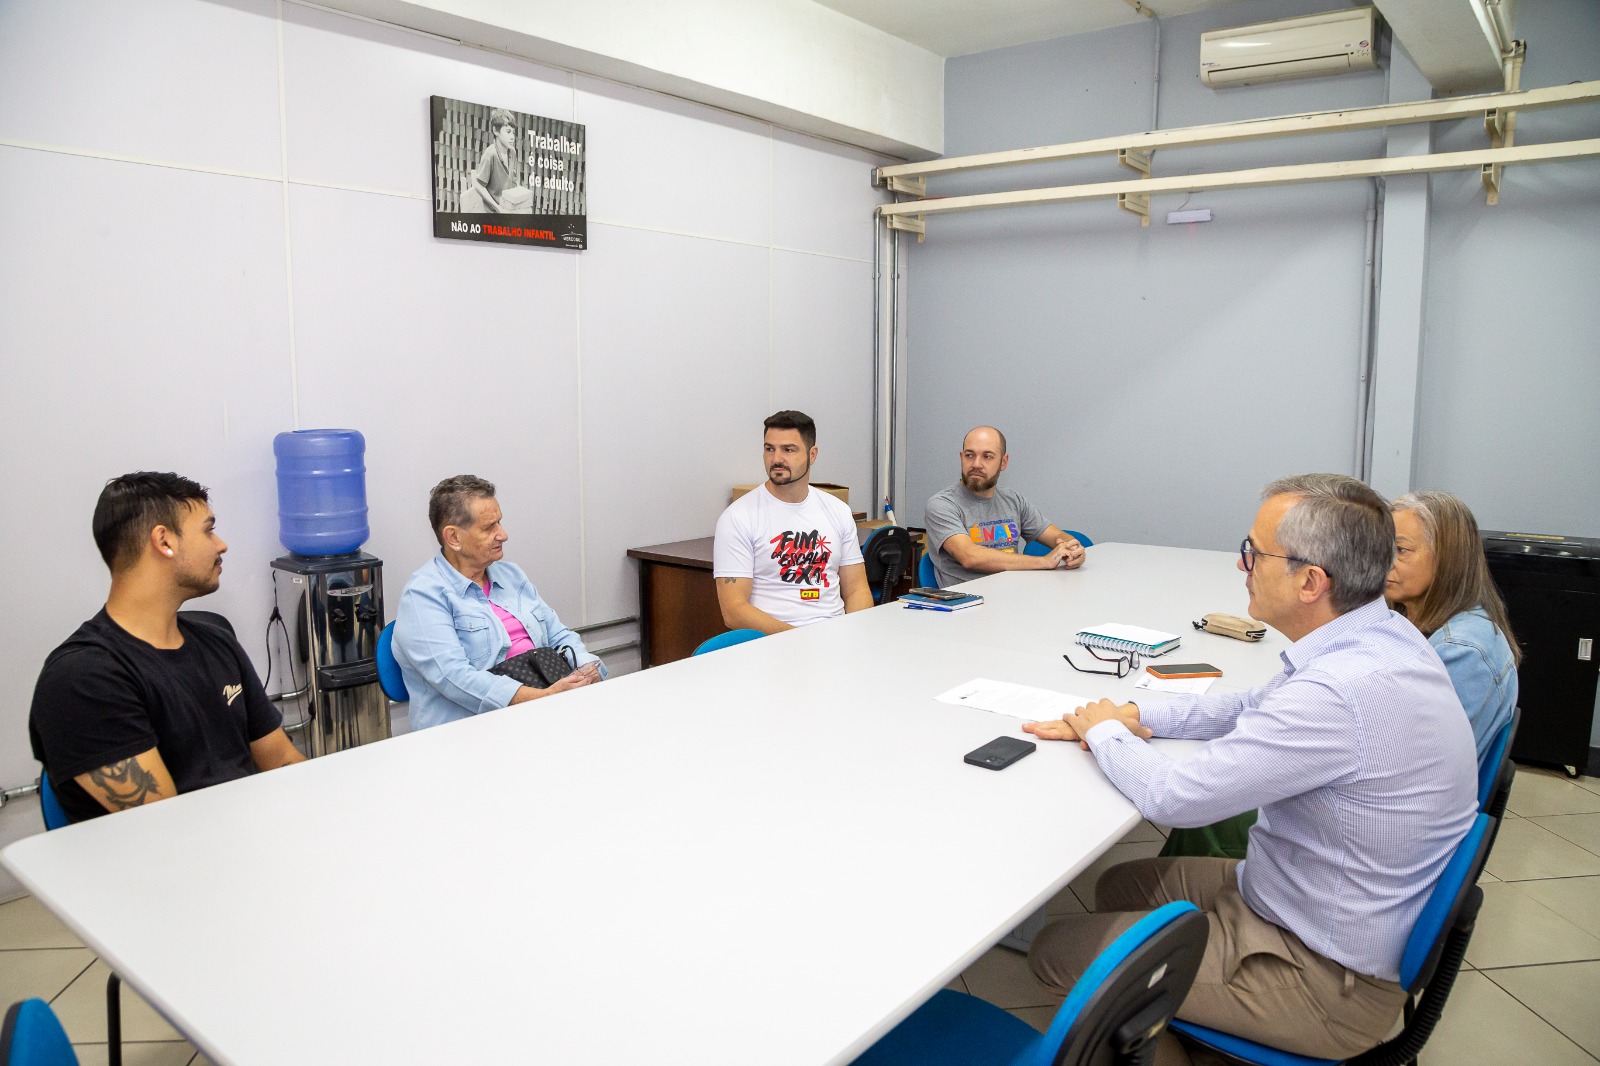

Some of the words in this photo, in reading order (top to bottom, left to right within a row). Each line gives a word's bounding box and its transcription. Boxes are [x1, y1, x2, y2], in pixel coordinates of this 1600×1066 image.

[528, 130, 581, 155] Trabalhar
[529, 151, 535, 167] é
[538, 155, 563, 171] coisa
[529, 172, 541, 188] de
[544, 174, 574, 192] adulto
[451, 221, 468, 233] NÃO
[470, 224, 481, 233] AO
[482, 224, 522, 237] TRABALHO
[523, 229, 556, 240] INFANTIL
[781, 529, 818, 550] FIM
[771, 551, 782, 559] DA
[780, 551, 829, 567] ESCALA
